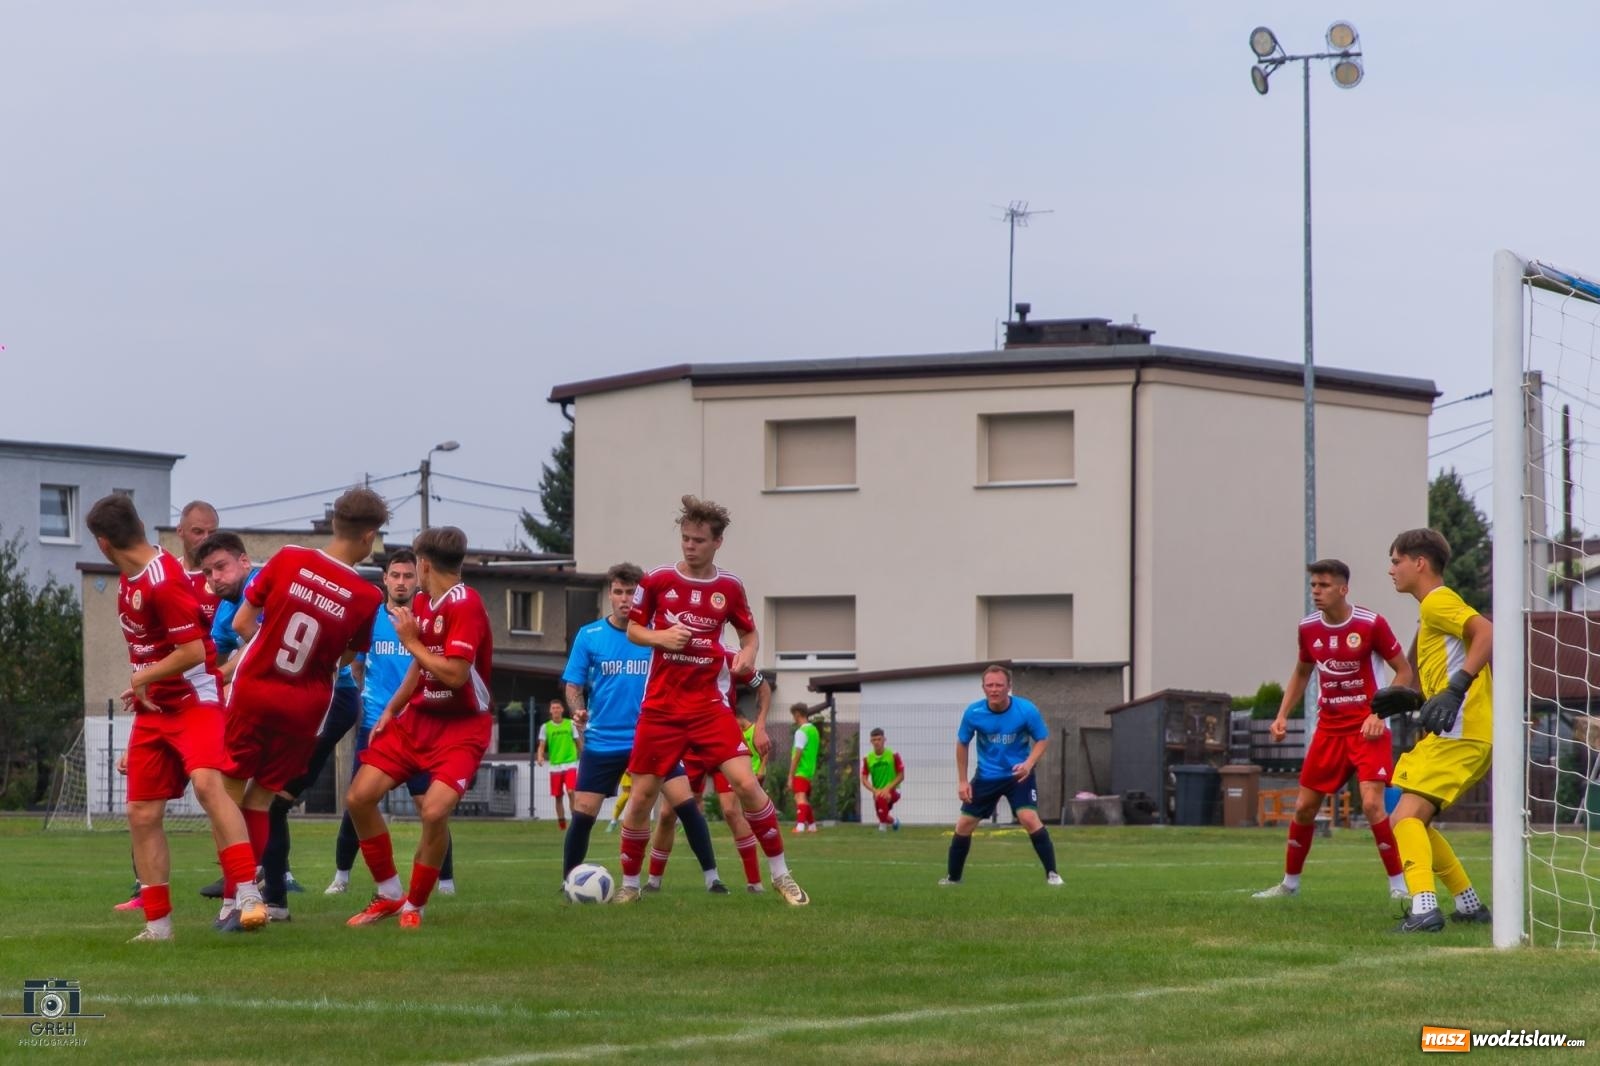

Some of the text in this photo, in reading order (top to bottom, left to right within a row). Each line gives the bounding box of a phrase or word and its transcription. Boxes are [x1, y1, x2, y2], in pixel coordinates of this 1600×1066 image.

[289, 581, 346, 619] UNIA TURZA
[275, 611, 319, 673] 9
[601, 659, 649, 676] DAR-BUD
[672, 653, 715, 665] WENINGER
[1031, 788, 1037, 802] 5
